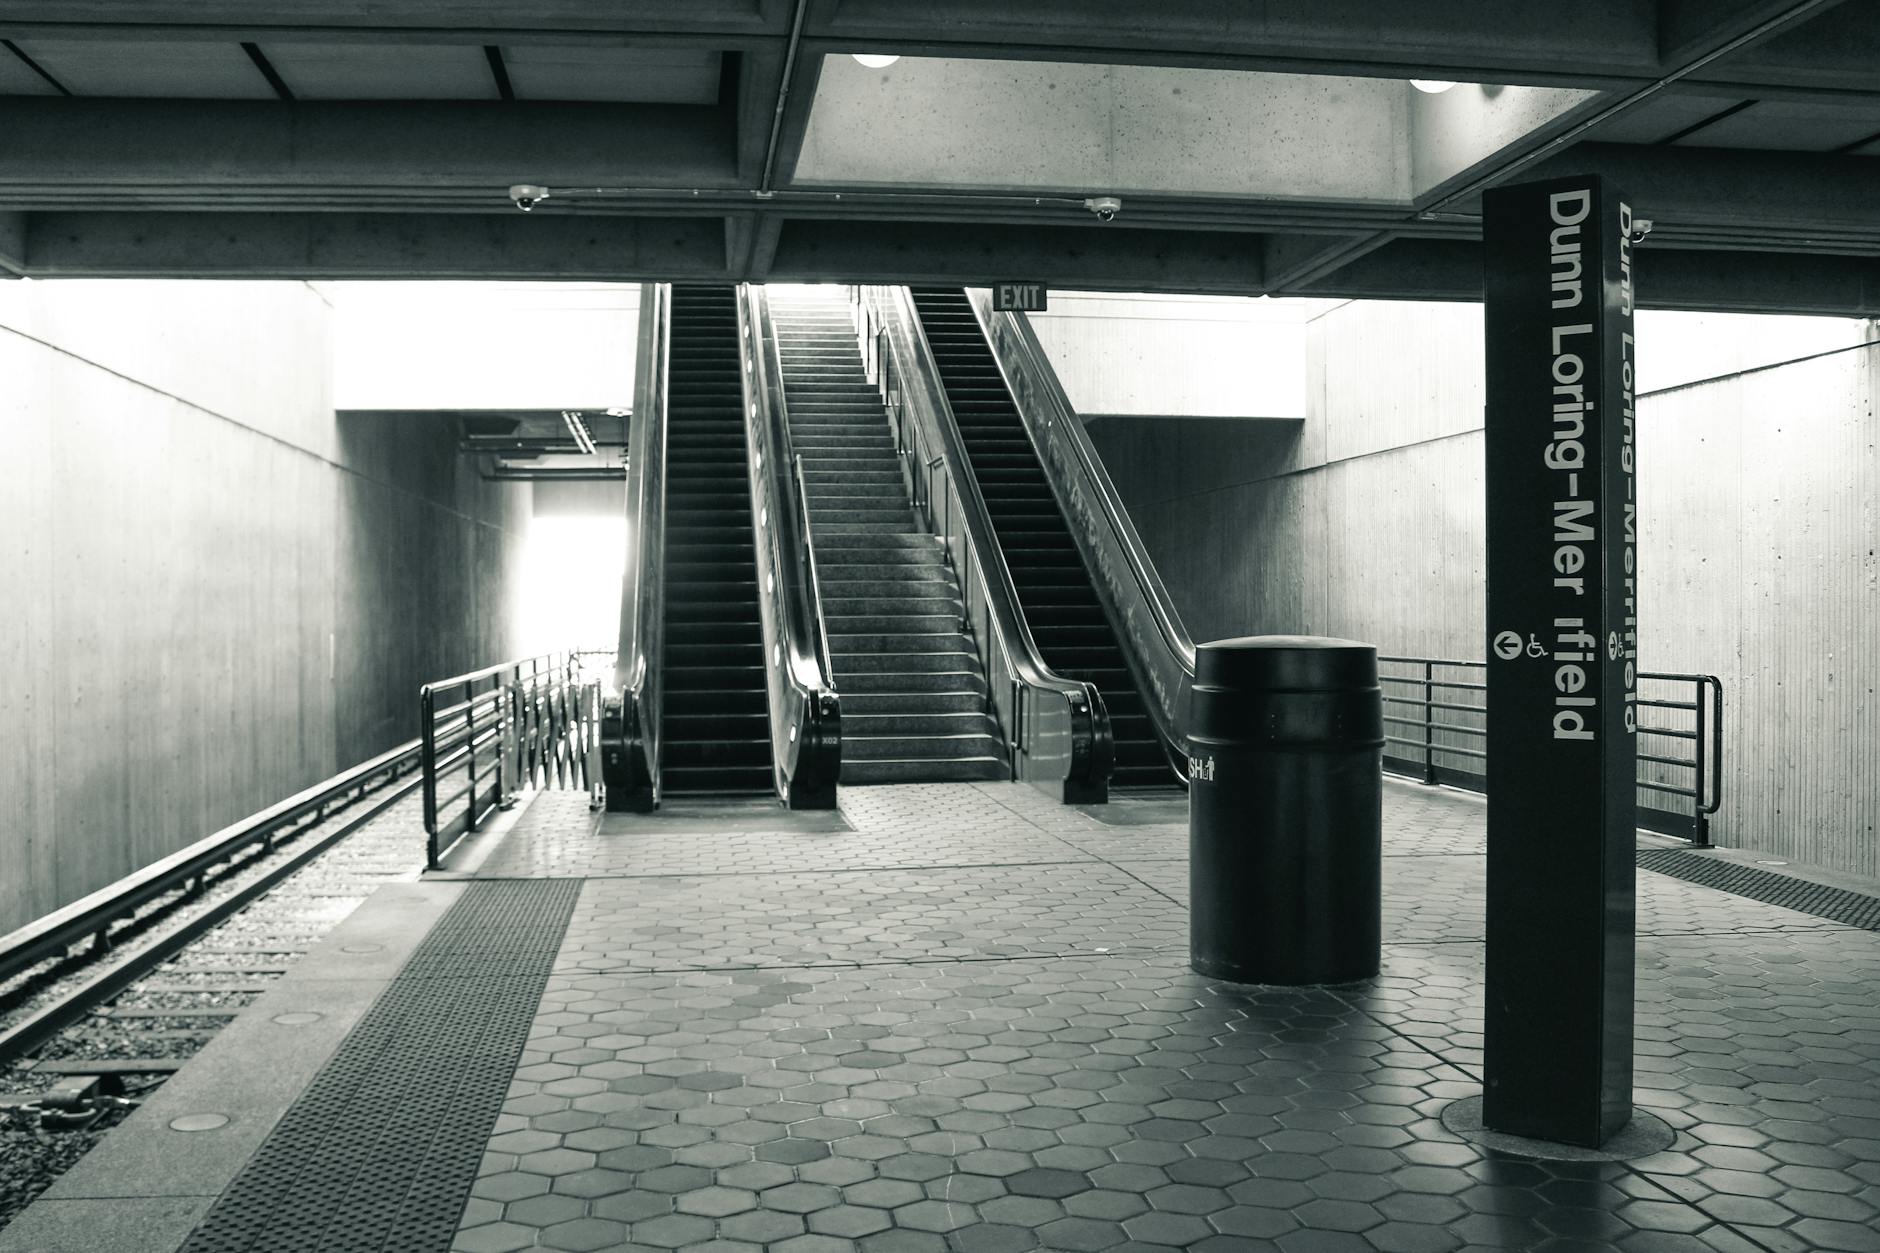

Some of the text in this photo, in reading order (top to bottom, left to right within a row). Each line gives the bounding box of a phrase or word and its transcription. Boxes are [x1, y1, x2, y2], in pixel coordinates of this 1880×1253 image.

[1000, 284, 1040, 309] EXIT
[1550, 189, 1591, 309] Dunn
[1620, 201, 1636, 734] Dunn Loring-Merrifield
